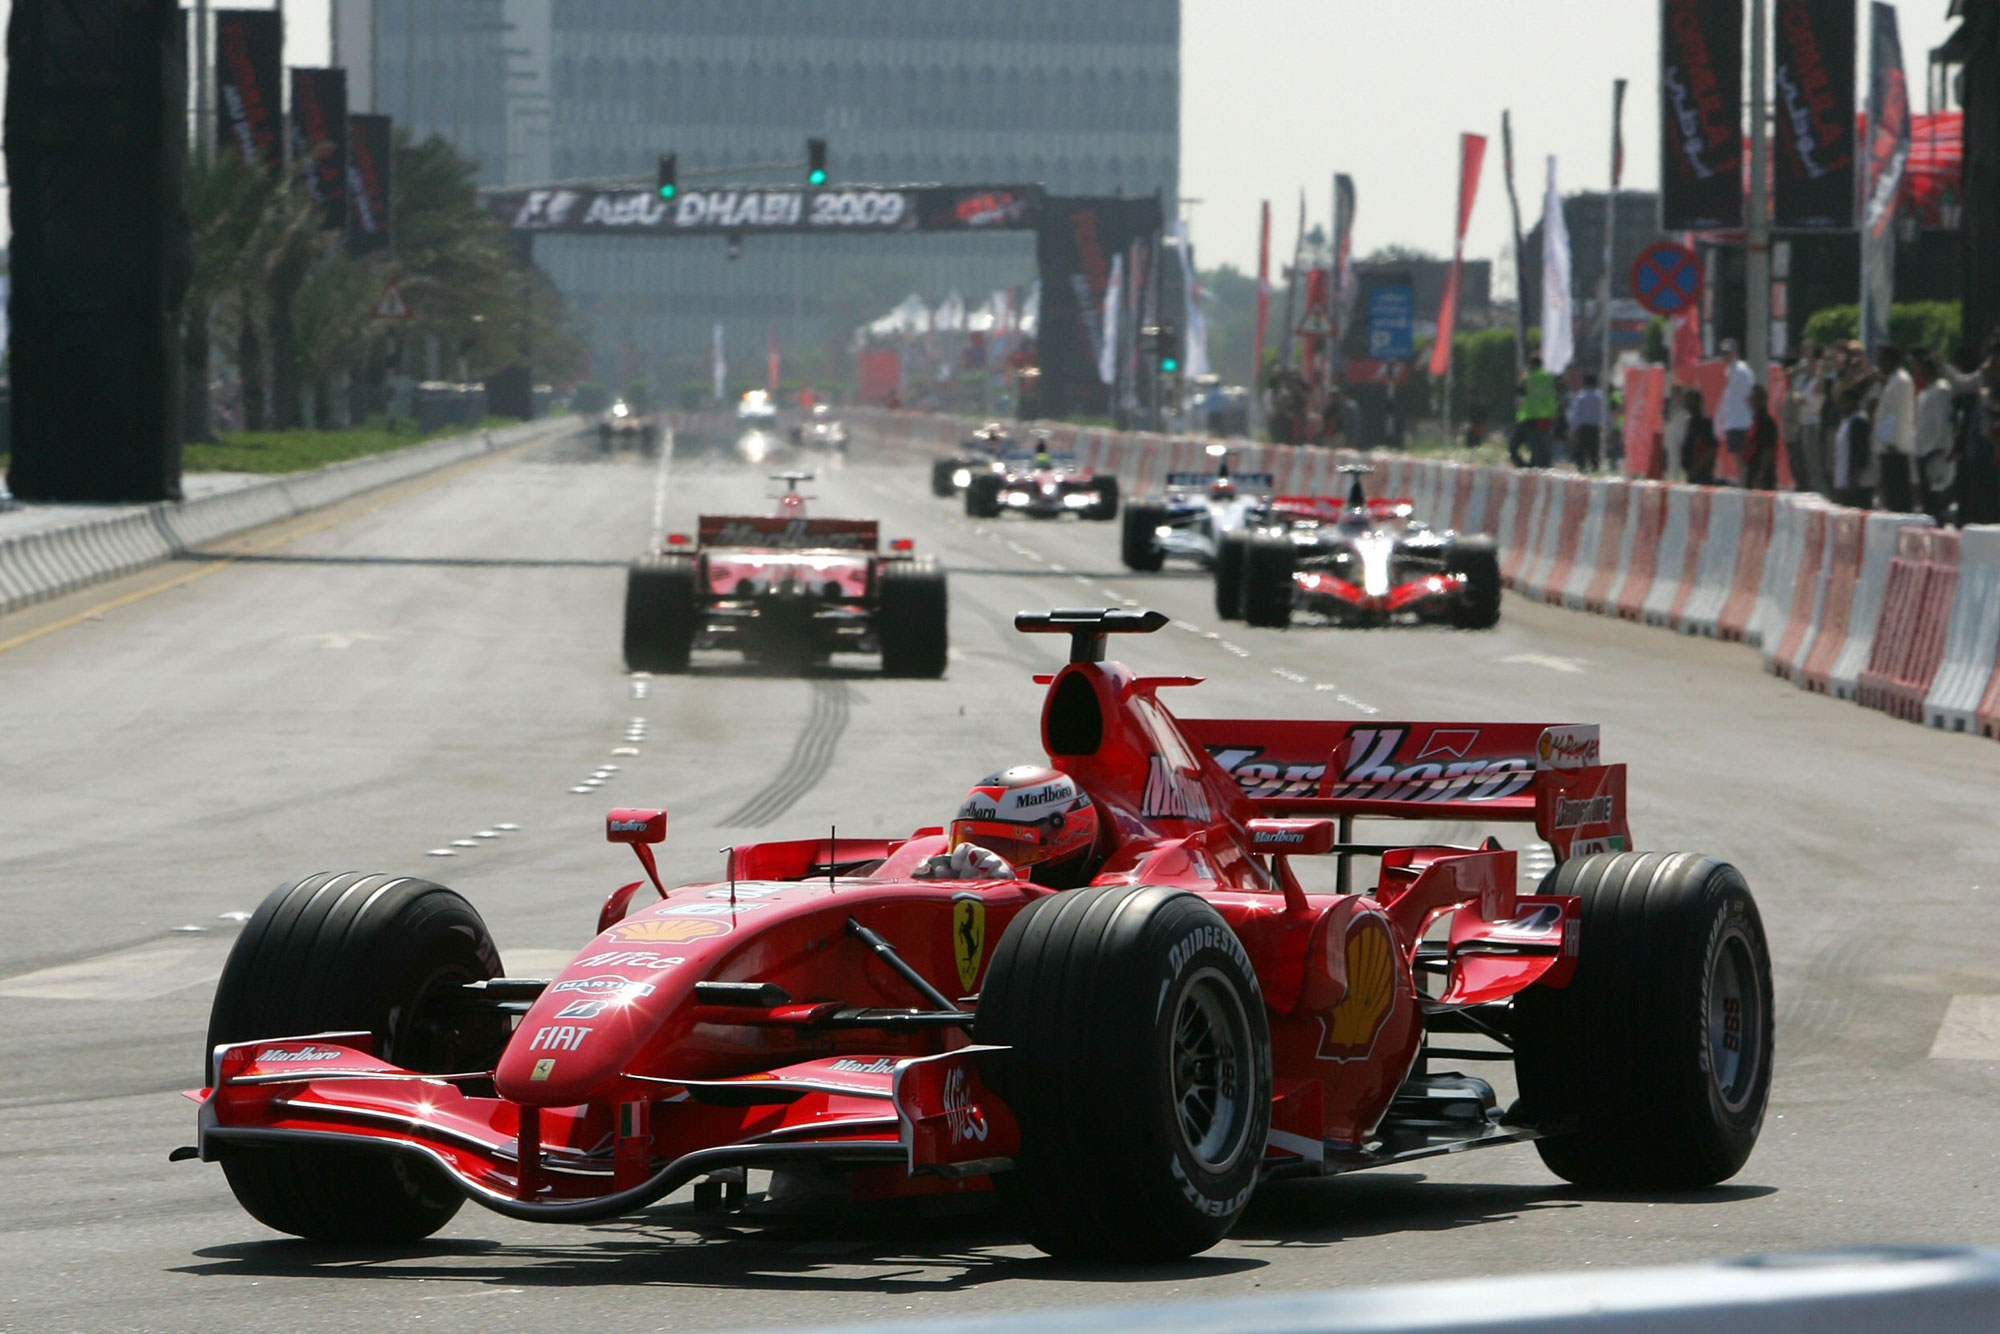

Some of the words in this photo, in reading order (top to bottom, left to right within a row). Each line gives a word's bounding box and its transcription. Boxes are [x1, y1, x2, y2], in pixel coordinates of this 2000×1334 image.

[675, 192, 801, 226] DHABI
[808, 193, 904, 225] 2009
[1016, 785, 1072, 808] Marlboro
[961, 802, 996, 819] rlboro
[1253, 830, 1304, 843] Marlboro
[573, 951, 686, 969] Alice
[1168, 925, 1258, 995] BRIDGESTONE
[561, 981, 645, 997] MARTI
[529, 1026, 594, 1051] FIAT
[255, 1047, 342, 1062] Marlboro
[827, 1057, 895, 1074] Marlbo
